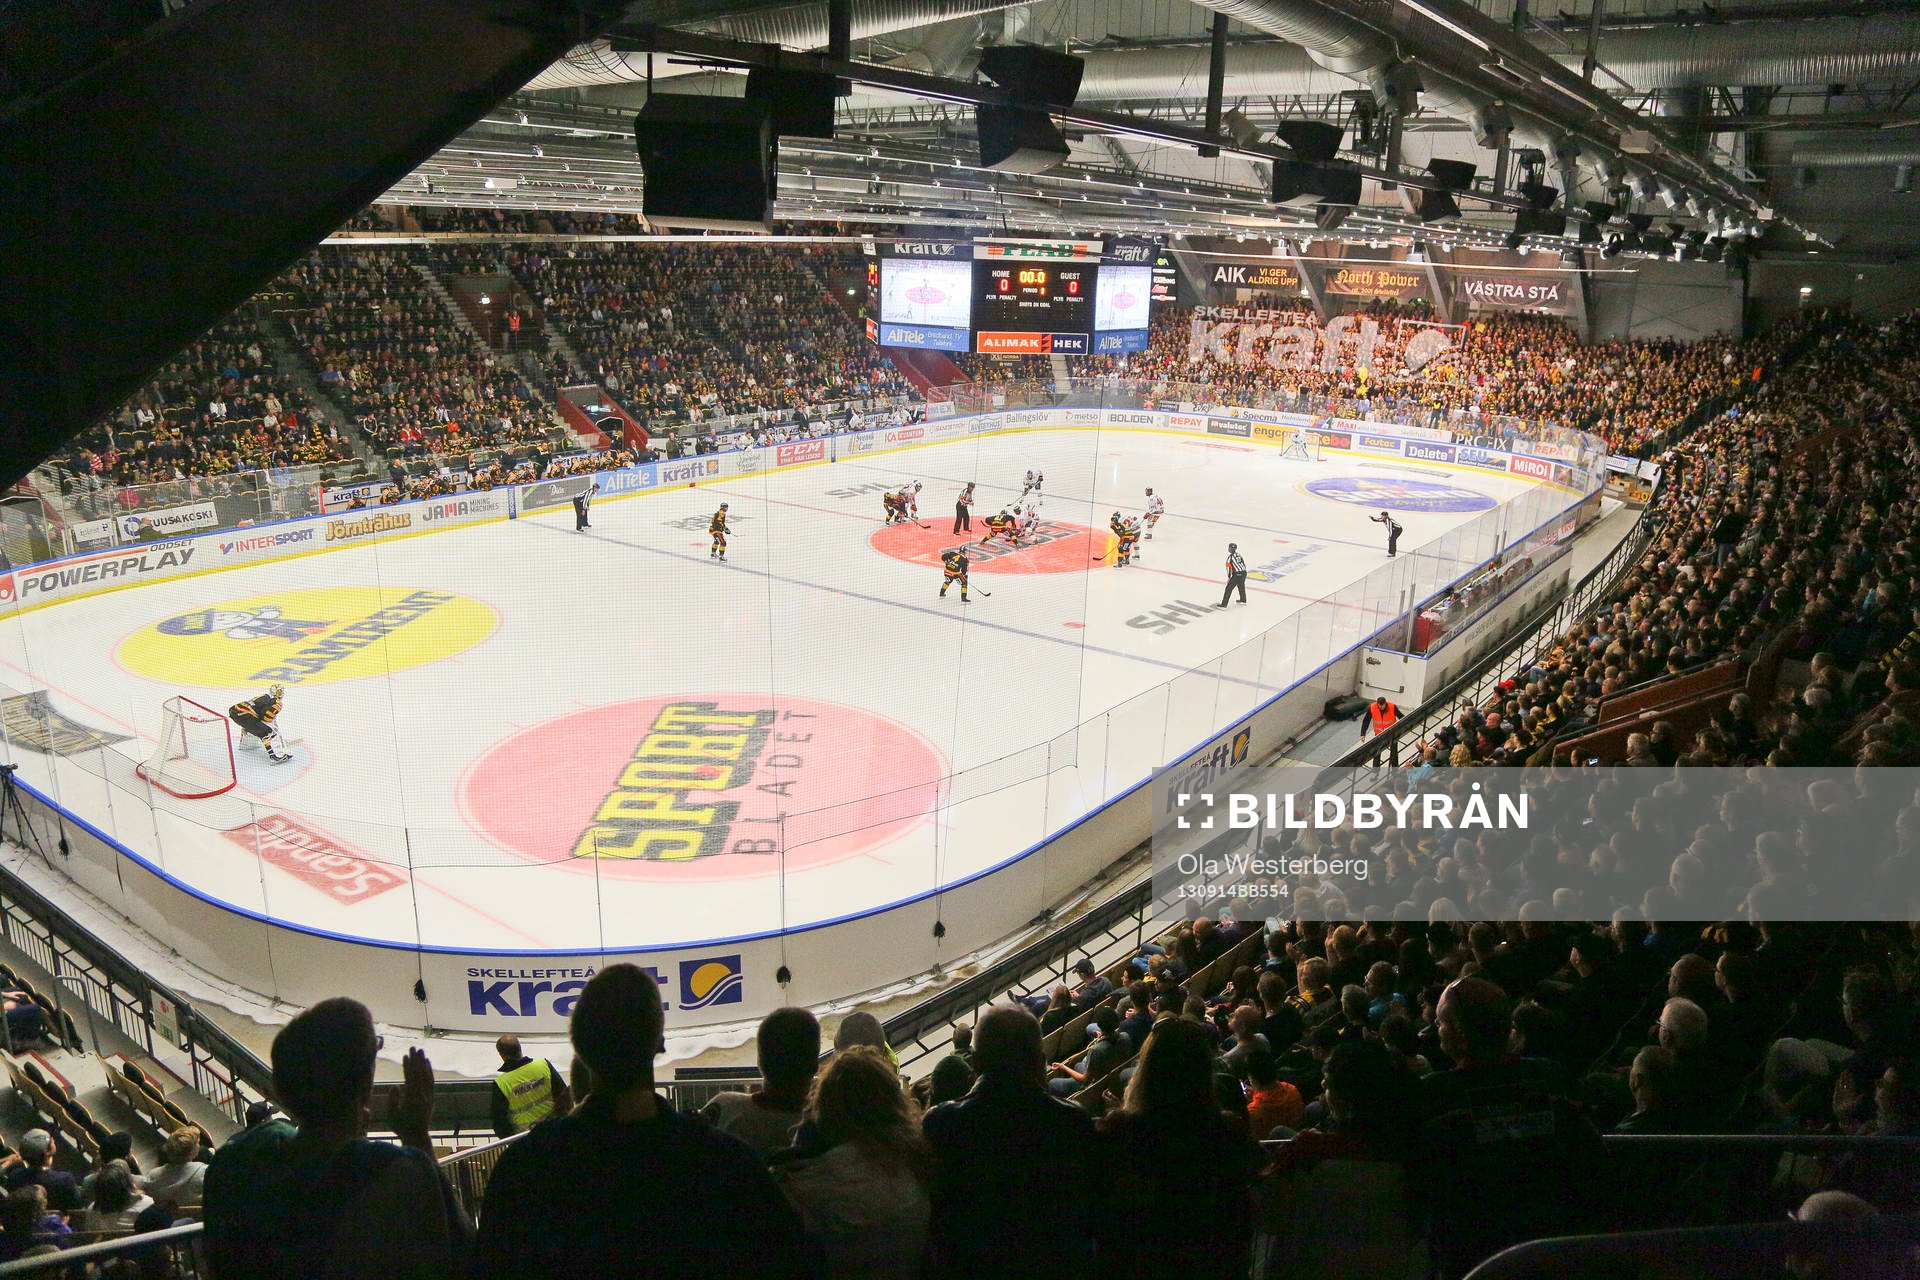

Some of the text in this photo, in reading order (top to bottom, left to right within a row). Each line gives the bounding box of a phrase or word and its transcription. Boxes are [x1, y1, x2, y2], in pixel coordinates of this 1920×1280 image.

[992, 270, 1010, 278] HOME
[1020, 271, 1046, 283] 00.0
[1060, 272, 1080, 280] GUEST
[1214, 266, 1247, 284] AIK
[1259, 268, 1287, 277] VI GER
[1335, 269, 1420, 288] North Power
[1000, 279, 1009, 291] 0
[1069, 281, 1078, 293] 0
[1248, 276, 1298, 286] ALDRIG UPP
[1464, 281, 1525, 298] VÄSTRA
[888, 328, 925, 344] AllTele
[983, 338, 1082, 348] ALIMAK HEK
[1099, 335, 1123, 350] AllTele
[1189, 315, 1387, 374] kraft
[1006, 412, 1049, 424] Ballingslöv
[1110, 414, 1154, 424] BOLIDEN
[1170, 416, 1202, 427] REPAY
[1242, 411, 1278, 423] Specma
[1254, 427, 1294, 439] engco
[780, 442, 822, 457] CCM
[1408, 445, 1448, 460] Delete
[663, 462, 704, 483] kraft
[605, 470, 650, 492] AllTele
[422, 501, 468, 521] JAMA
[325, 512, 411, 541] Jörnträhus
[150, 539, 194, 552] ODDSET
[235, 528, 314, 553] INTERSPORT
[22, 548, 195, 598] POWERPLAY
[248, 591, 456, 684] RAMIRENT
[1168, 752, 1211, 785] SKELLEFTEÅ
[571, 702, 774, 861] SPORT
[732, 709, 817, 855] BLADET
[1166, 743, 1230, 814] kraft
[467, 966, 597, 979] SKELLEFTEÅ
[467, 967, 670, 1017] krat
